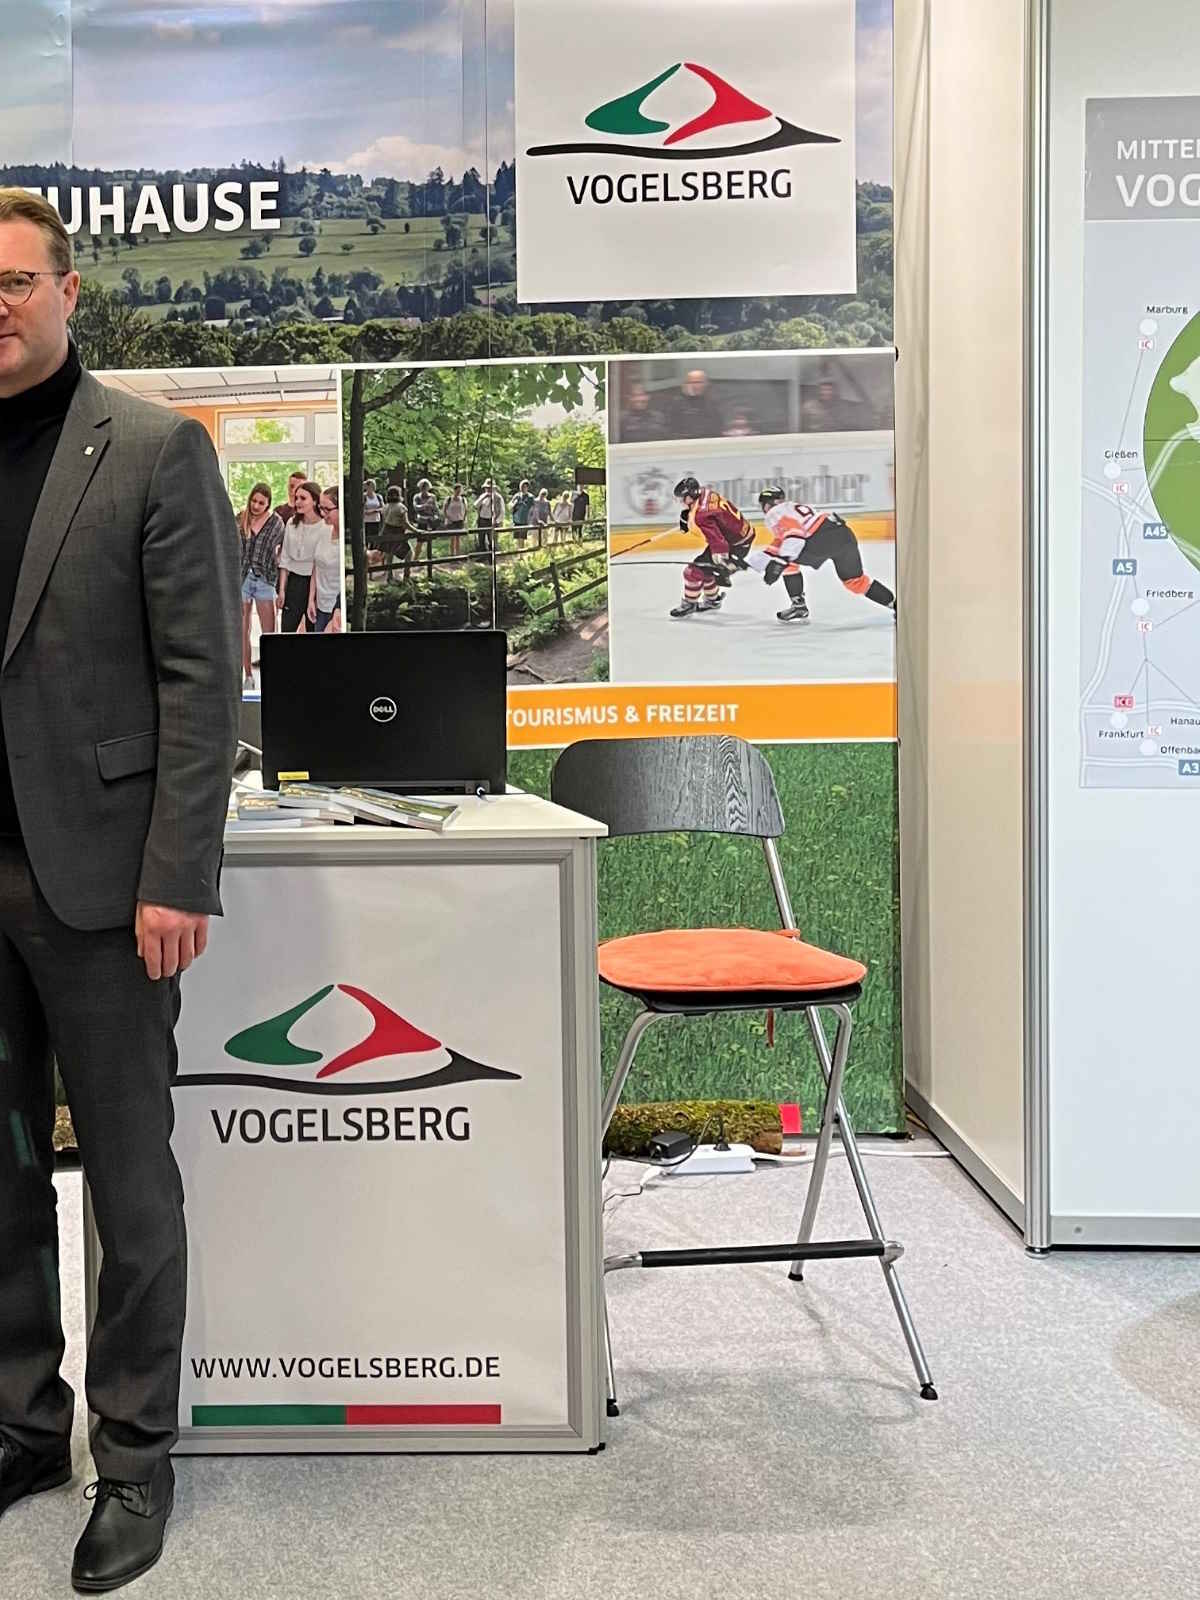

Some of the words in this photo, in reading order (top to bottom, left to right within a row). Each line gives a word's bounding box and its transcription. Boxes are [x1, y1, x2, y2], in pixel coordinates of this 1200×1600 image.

[1117, 138, 1200, 159] MITTE
[566, 169, 792, 205] VOGELSBERG
[23, 181, 281, 235] UHAUSE
[1145, 305, 1188, 315] Marburg
[1104, 450, 1138, 459] Gießen
[1144, 526, 1167, 537] A45
[1116, 562, 1134, 573] A5
[1146, 589, 1194, 599] Friedberg
[373, 705, 394, 713] DELL
[625, 704, 640, 723] &
[647, 703, 739, 722] FREIZEIT
[1170, 717, 1200, 726] Hanau
[1098, 730, 1144, 738] Frankfurt
[1160, 745, 1200, 754] Offenba
[1182, 763, 1200, 774] A3
[210, 1106, 471, 1144] VOGELSBERG
[191, 1356, 501, 1379] WWW.VOGELSBERG.DE
